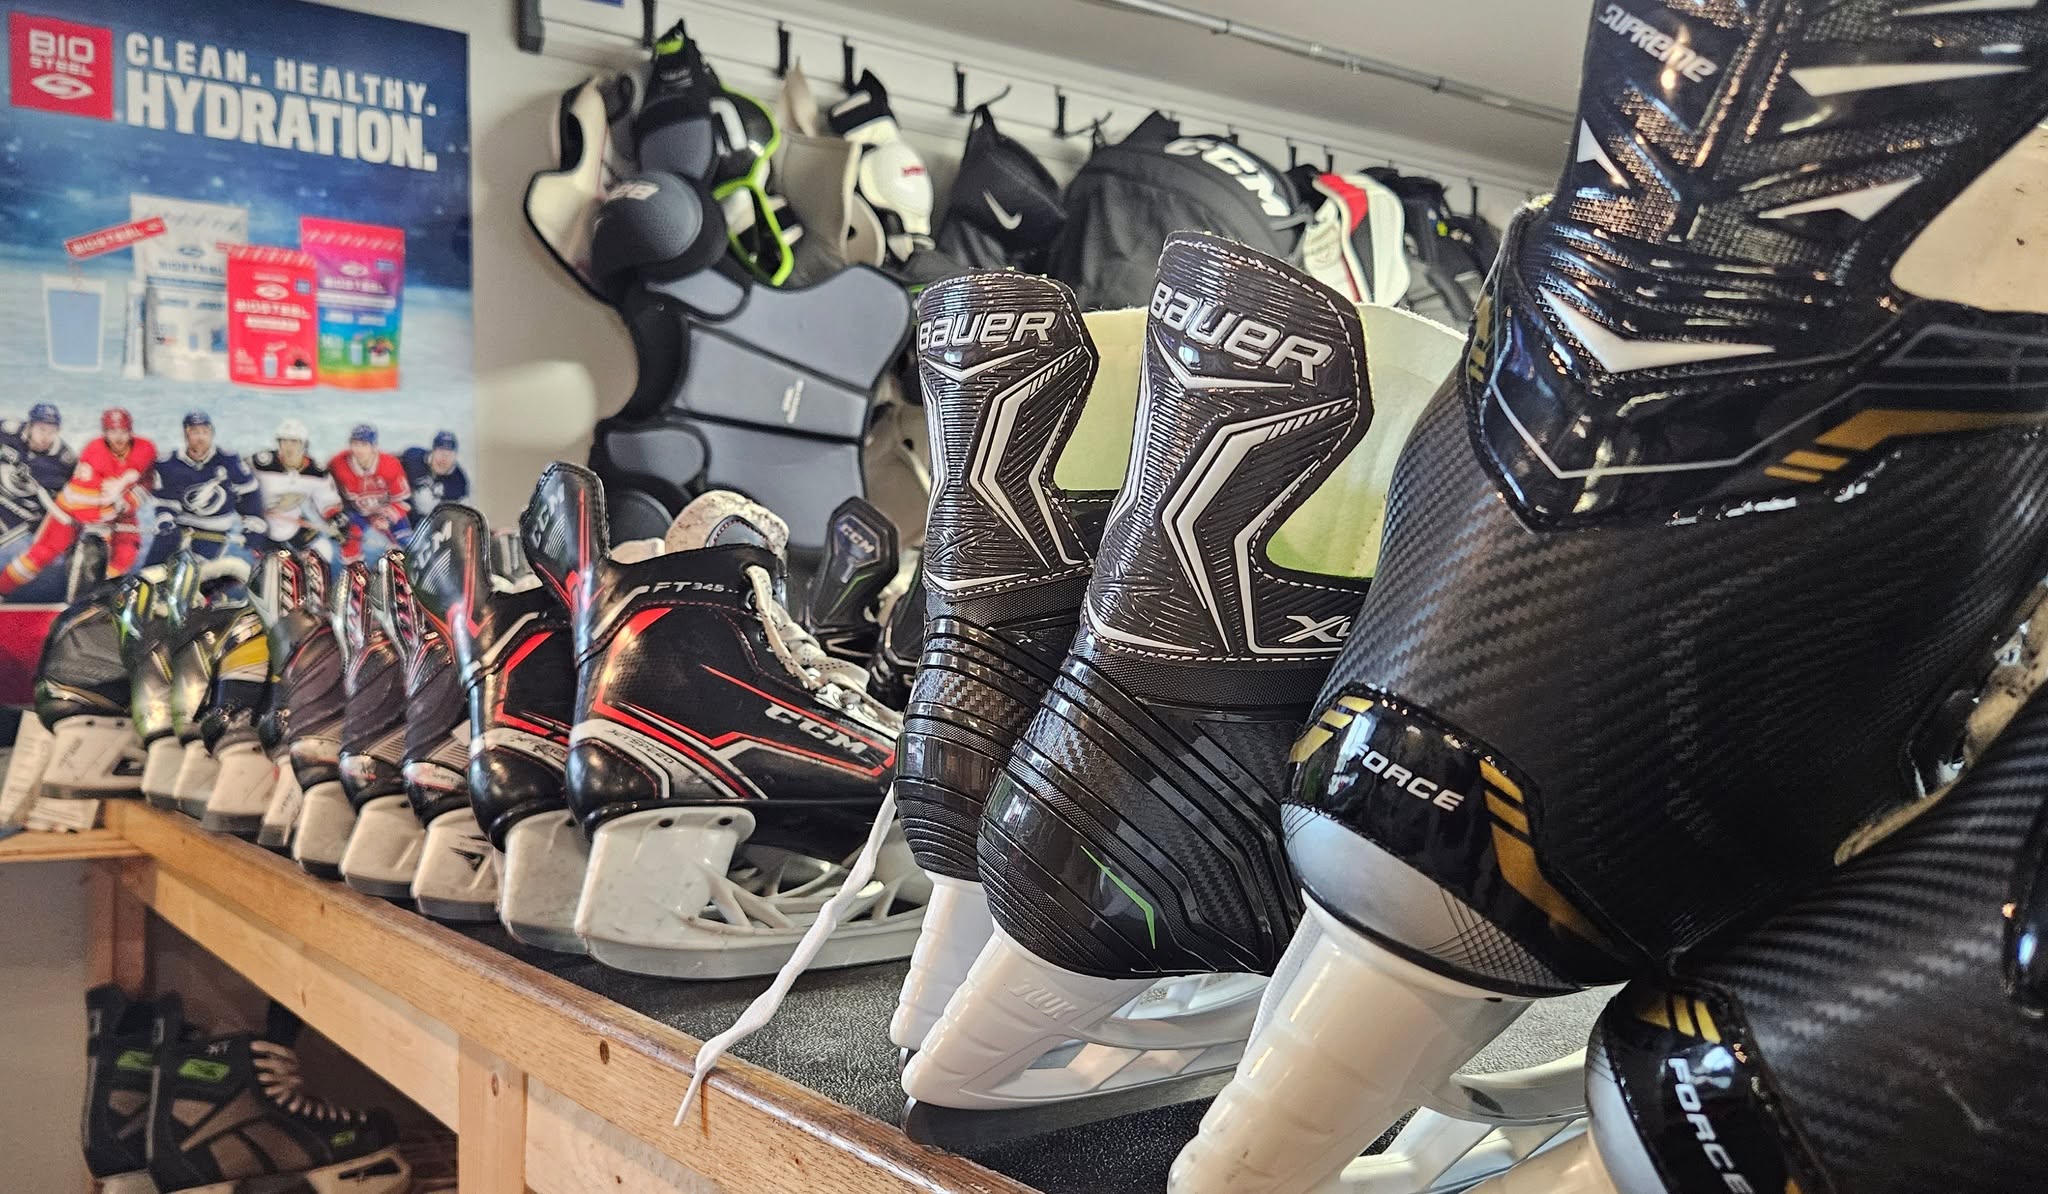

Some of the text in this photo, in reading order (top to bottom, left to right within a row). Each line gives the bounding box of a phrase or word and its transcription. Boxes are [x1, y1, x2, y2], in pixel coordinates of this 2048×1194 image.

[28, 29, 94, 64] BIO
[29, 56, 94, 77] STEEL
[126, 32, 437, 117] CLEAN. HEALTHY.
[126, 68, 437, 172] HYDRATION.
[1164, 138, 1289, 216] CCM
[918, 311, 1056, 351] BAUER
[1150, 282, 1333, 381] BAUER
[410, 520, 452, 587] CCM
[839, 523, 876, 553] CCM
[764, 702, 868, 754] CCM
[1350, 743, 1465, 812] FORCE
[1667, 1057, 1755, 1194] FORCE
